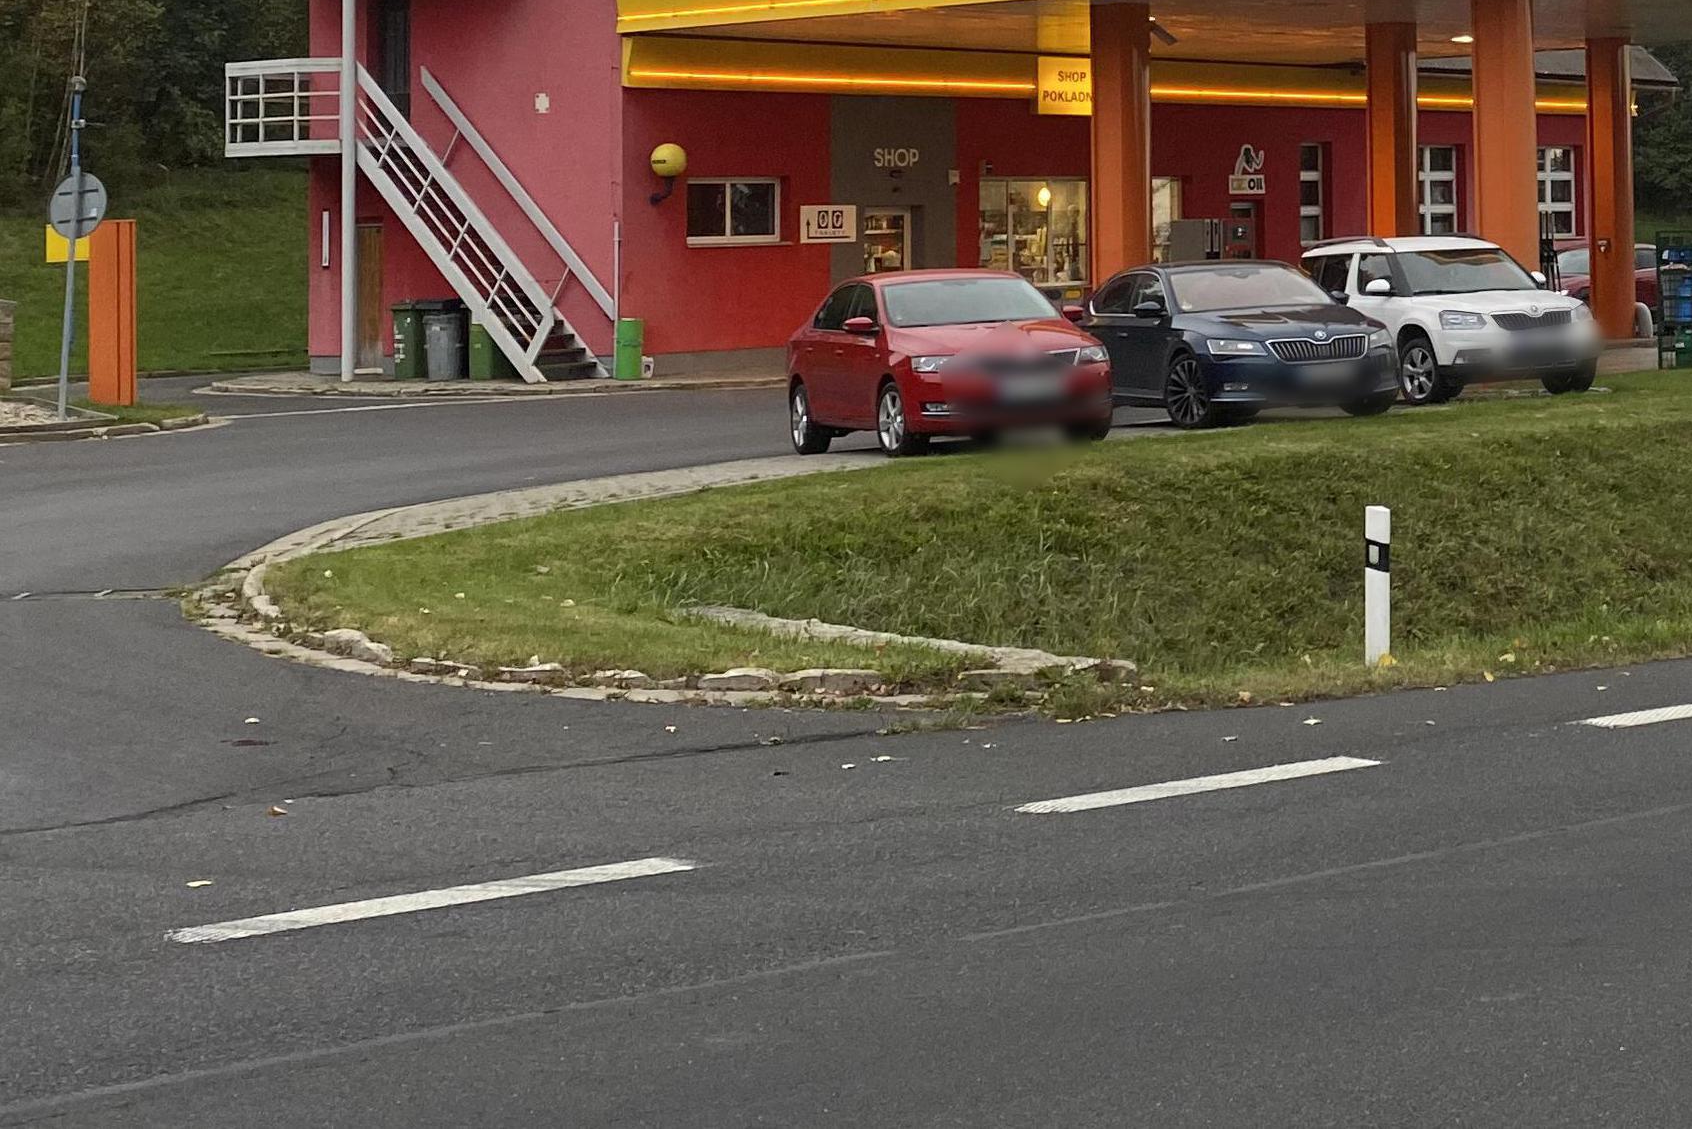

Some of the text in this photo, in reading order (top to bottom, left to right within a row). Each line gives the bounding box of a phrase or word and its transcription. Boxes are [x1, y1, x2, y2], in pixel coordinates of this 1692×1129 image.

[1057, 70, 1087, 82] SHOP
[1042, 90, 1093, 102] POKLADN
[874, 148, 919, 167] SHOP
